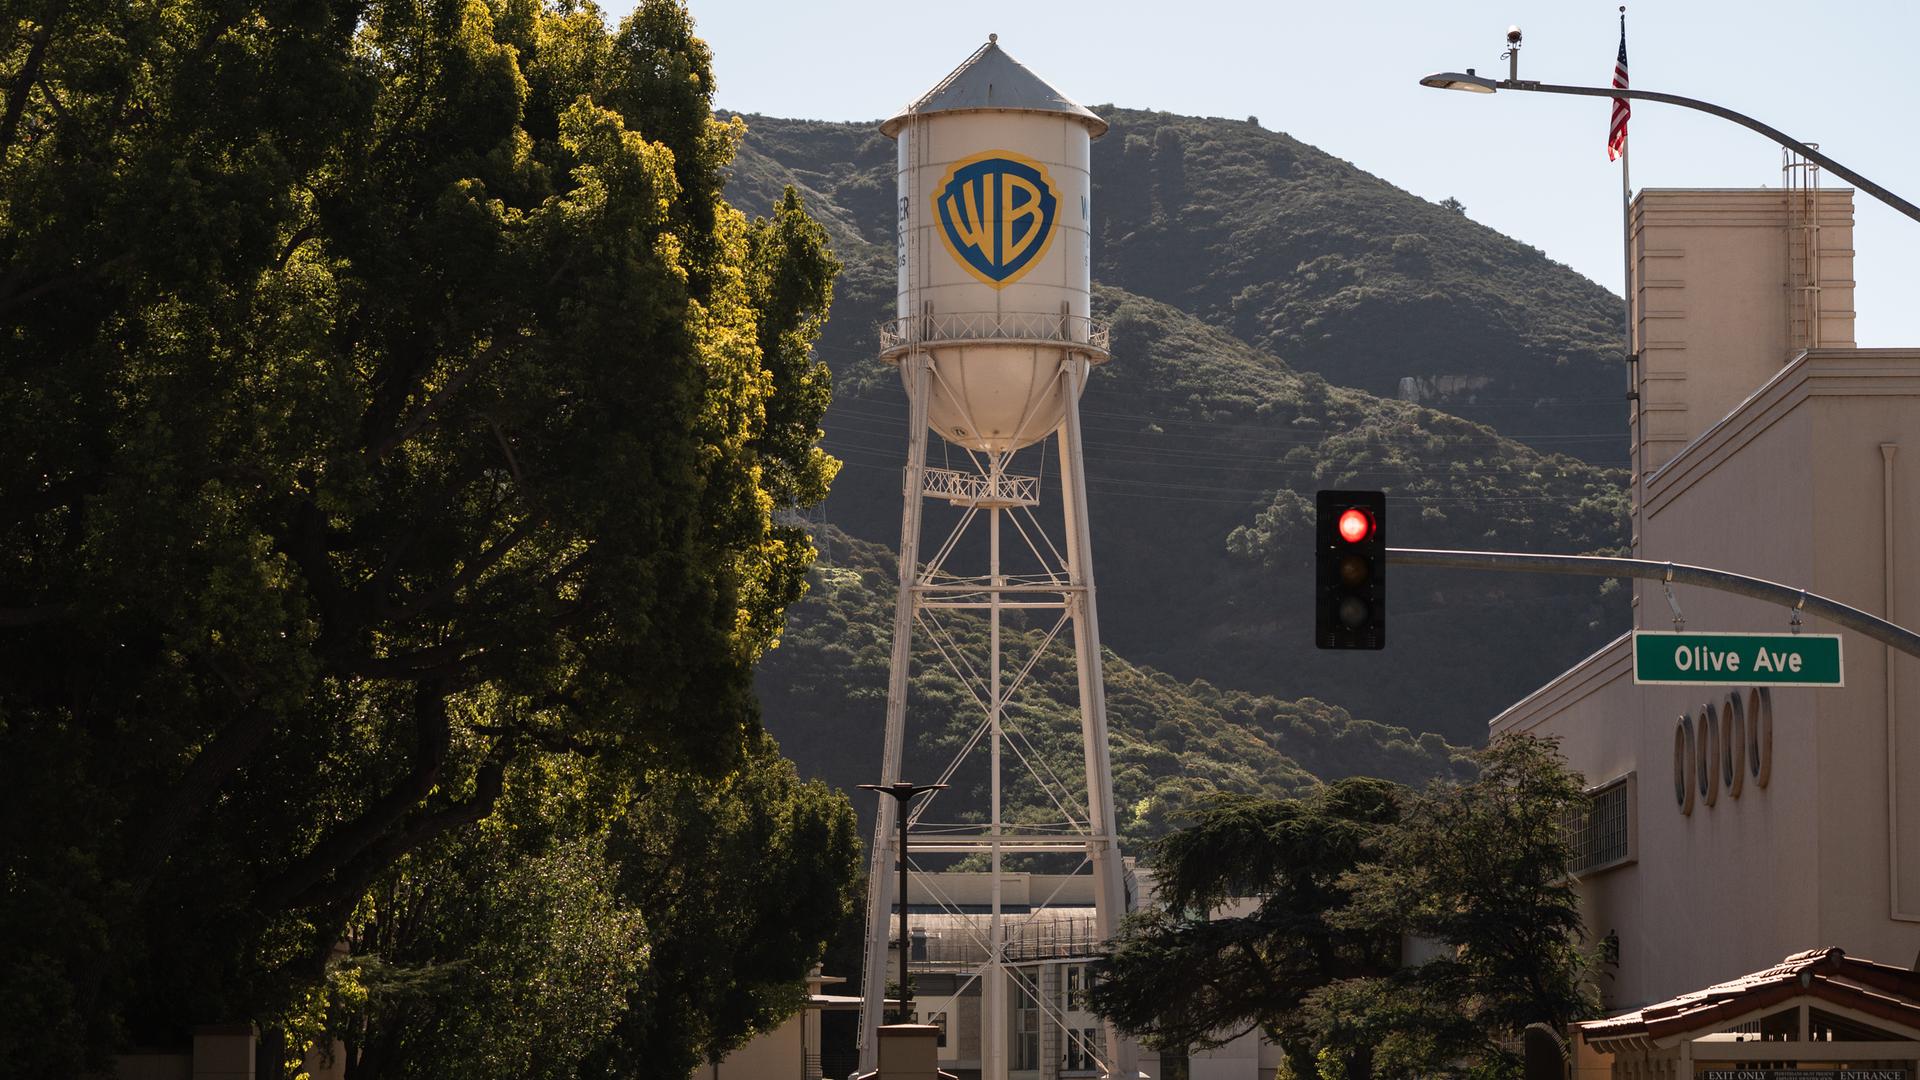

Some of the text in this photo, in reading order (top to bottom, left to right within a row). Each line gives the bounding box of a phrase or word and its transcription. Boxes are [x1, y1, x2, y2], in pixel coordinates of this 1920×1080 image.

[946, 173, 1044, 267] WB
[1675, 645, 1803, 672] Olive Ave
[1709, 1071, 1735, 1080] EXIT
[1737, 1071, 1767, 1080] ONLY
[1840, 1071, 1901, 1080] ENTRANCE
